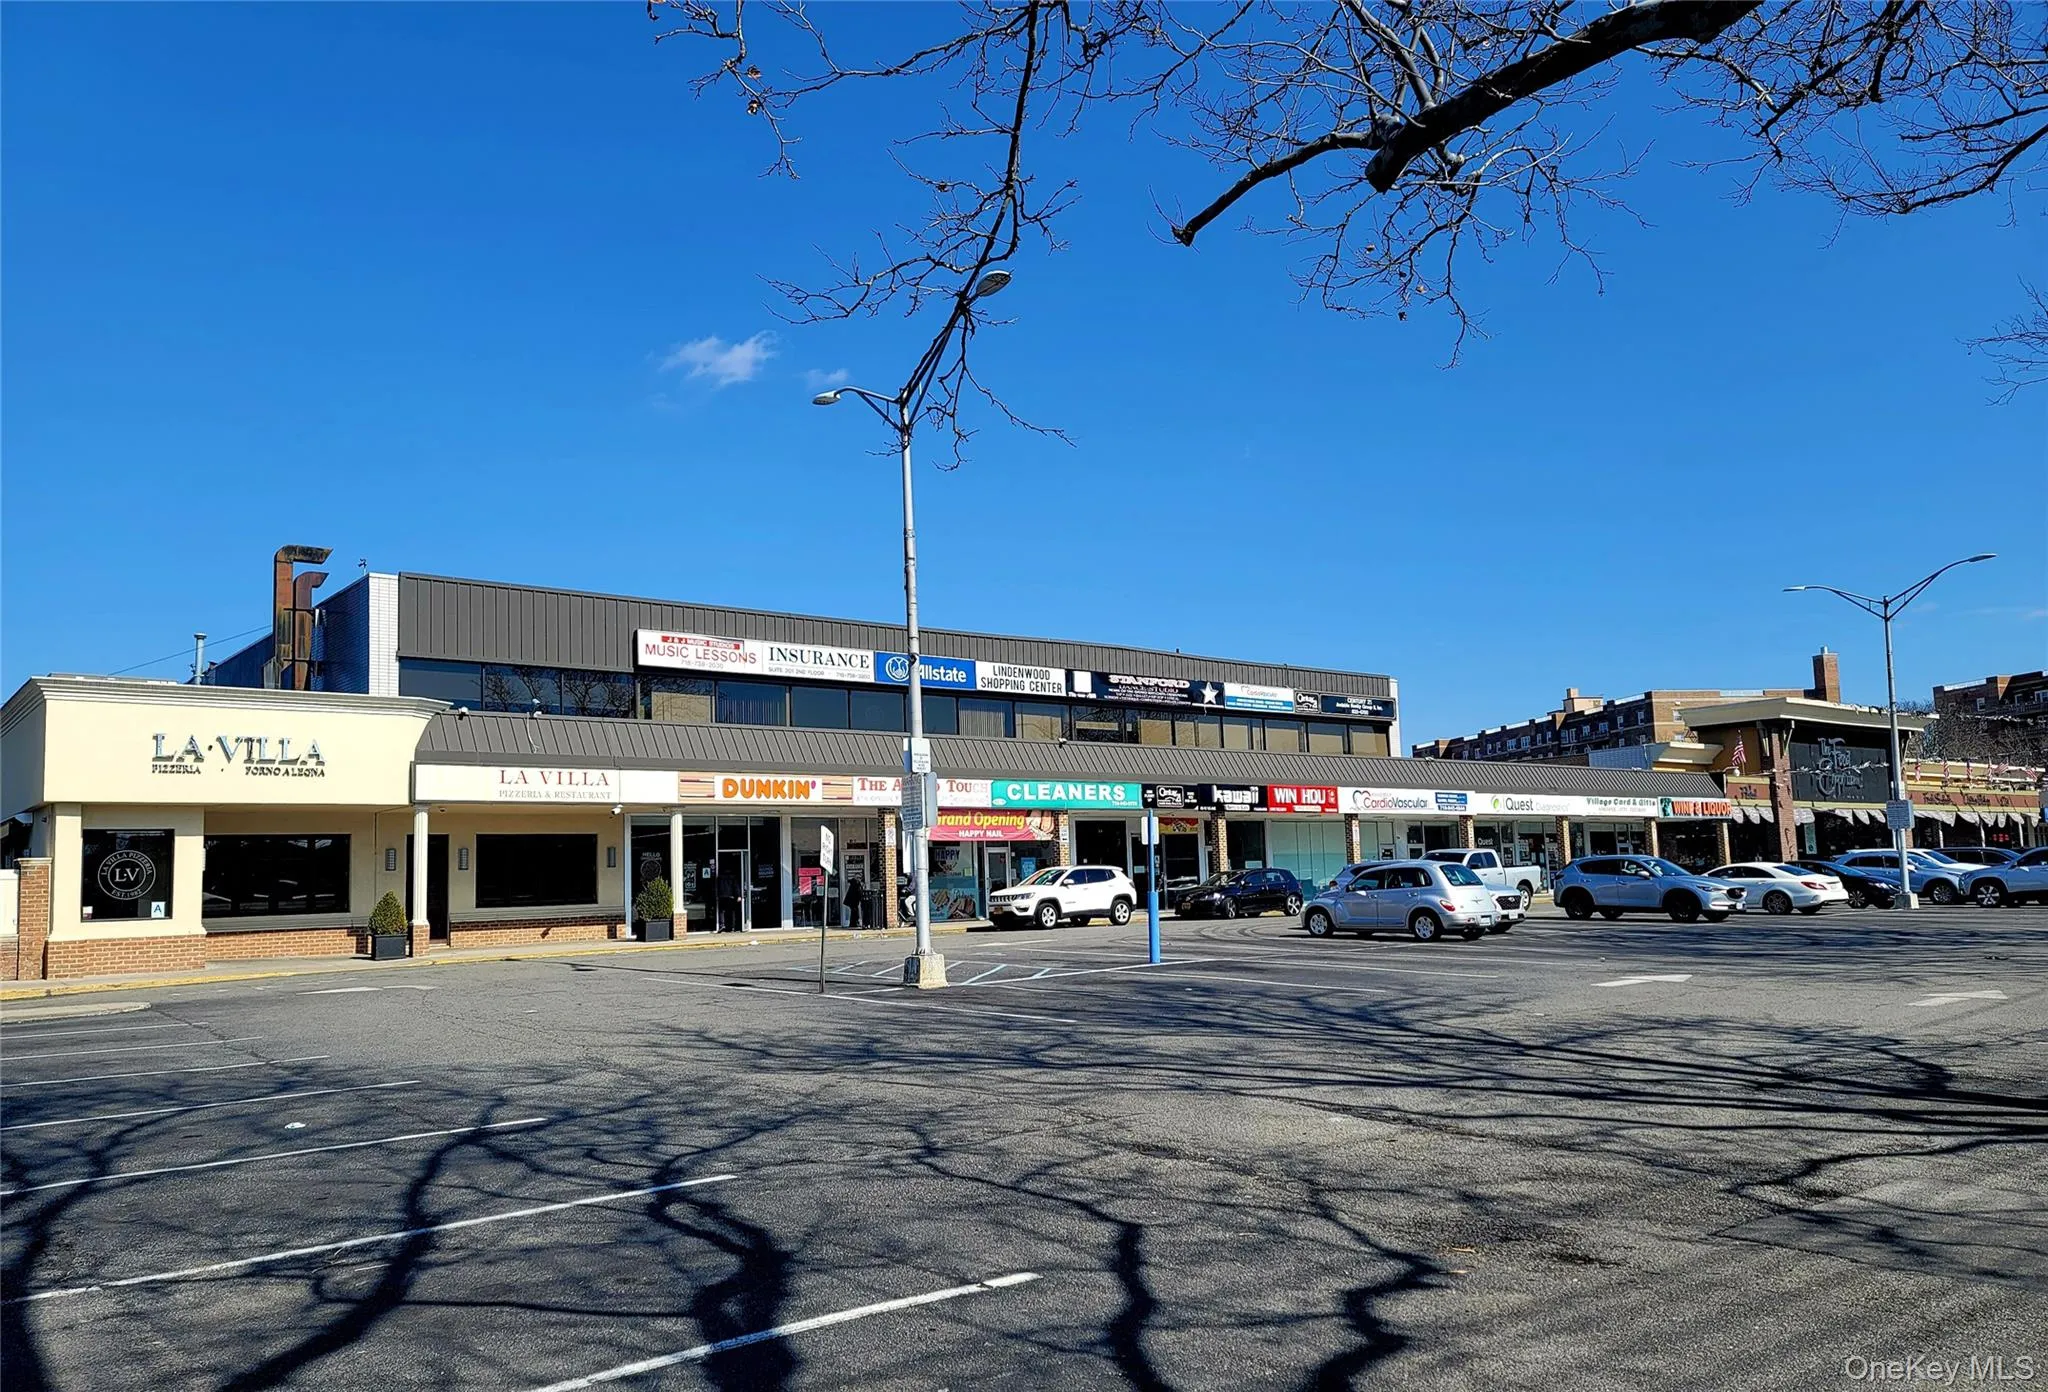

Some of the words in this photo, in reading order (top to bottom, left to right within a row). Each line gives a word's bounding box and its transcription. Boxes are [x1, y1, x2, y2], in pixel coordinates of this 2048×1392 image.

[645, 643, 689, 658] MUSIC
[695, 648, 757, 664] LESSONS
[769, 646, 870, 669] INSURANCE
[918, 663, 967, 683] Allstate
[993, 664, 1051, 681] LINDENWOOD
[1108, 674, 1191, 689] STANFORD
[981, 676, 1026, 692] SHOPPING
[1029, 680, 1063, 694] CENTER
[152, 733, 205, 763] LA
[215, 735, 326, 766] VILLA
[151, 764, 201, 775] PIZZERIA
[245, 766, 281, 777] FORNO
[281, 767, 290, 777] A
[499, 769, 529, 785] LA
[538, 770, 609, 787] VILLA
[499, 789, 542, 799] PIZZERIA
[544, 791, 552, 799] &
[554, 790, 612, 800] RESTAURANT
[722, 777, 817, 800] DUNKIN'
[1006, 783, 1126, 801] CLEANERS
[1211, 784, 1260, 804] kawaii
[1273, 787, 1298, 804] WIN
[1301, 788, 1326, 805] HOU
[1363, 796, 1428, 809] CardioVascular
[1505, 797, 1534, 812] Quest
[1586, 797, 1612, 807] Village
[1613, 798, 1631, 806] Card
[1639, 799, 1656, 807] Gifts
[1672, 800, 1693, 815] WINE
[973, 811, 1025, 829] Opening
[958, 829, 984, 838] HAPPY
[986, 829, 1004, 838] NAIL
[1477, 837, 1494, 847] Quest
[101, 866, 109, 875] LA
[105, 852, 128, 866] VILLA
[128, 852, 153, 875] PIZZERIA
